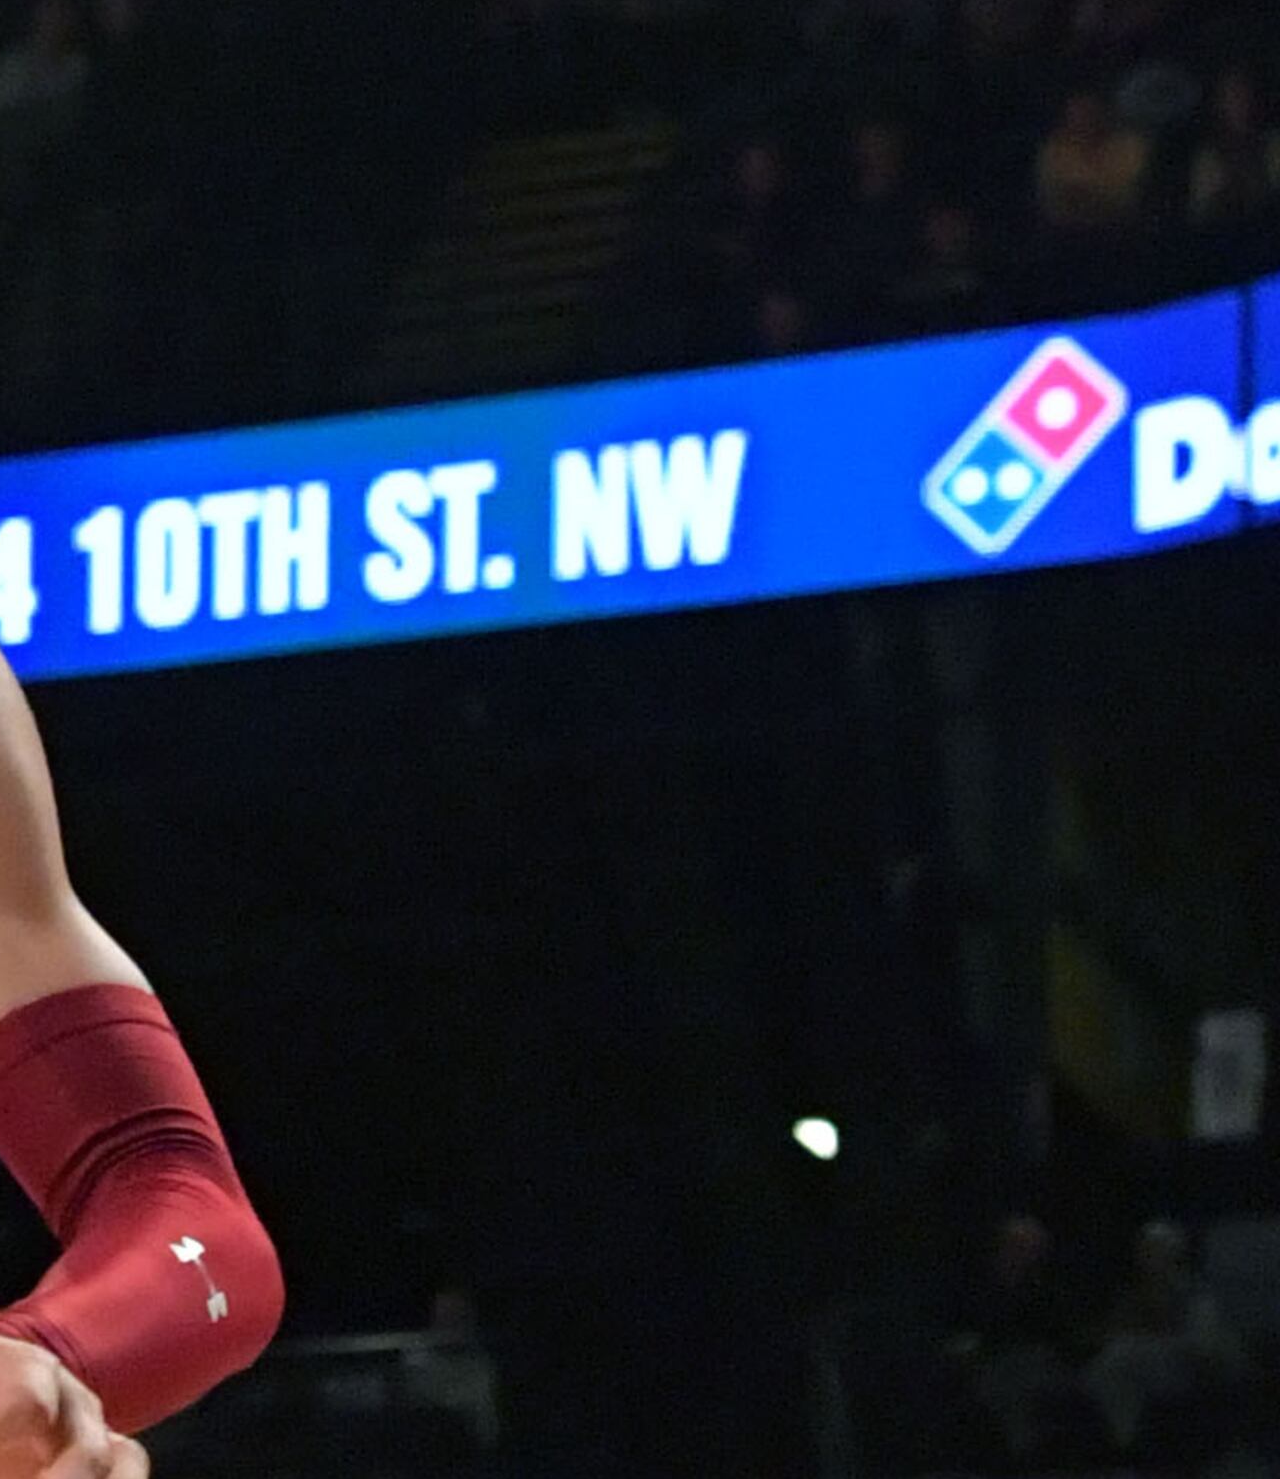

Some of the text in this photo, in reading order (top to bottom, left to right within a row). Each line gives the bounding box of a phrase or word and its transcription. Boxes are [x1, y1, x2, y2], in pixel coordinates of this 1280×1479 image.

[72, 483, 331, 636] 10TH
[362, 460, 516, 604] ST.
[552, 428, 748, 582] NW
